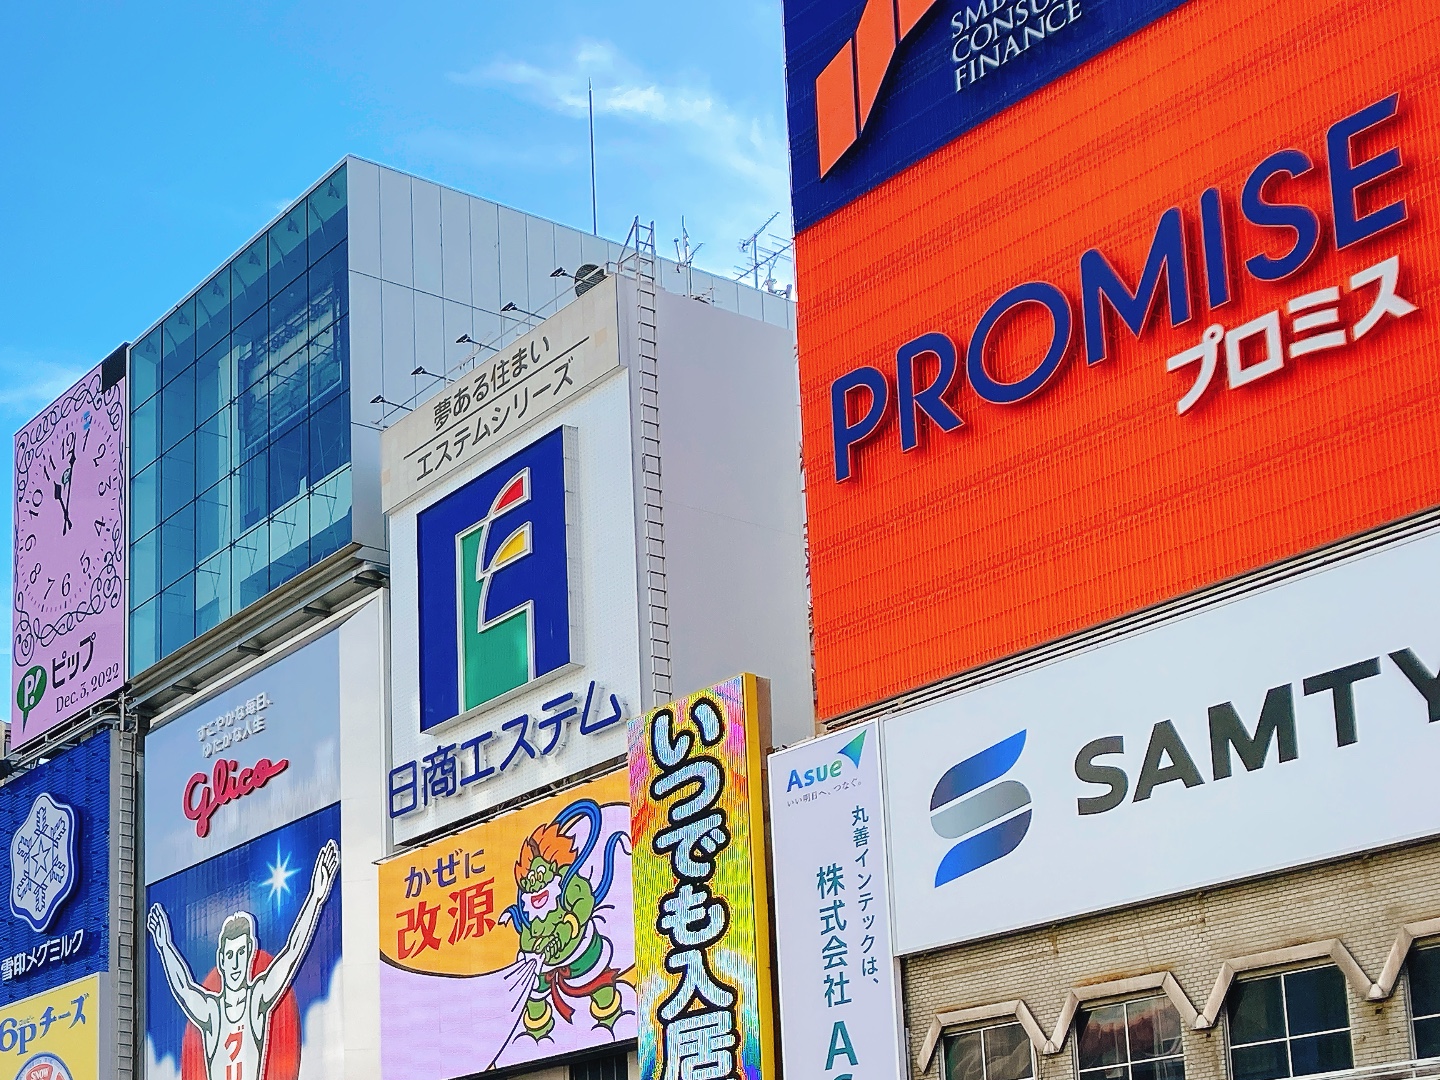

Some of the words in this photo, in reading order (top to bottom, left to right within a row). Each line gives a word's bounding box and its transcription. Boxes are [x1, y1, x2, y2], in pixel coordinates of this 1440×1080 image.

[952, 0, 1062, 62] CONSU
[954, 0, 1083, 93] FINANCE
[831, 91, 1409, 481] PROMISE
[1166, 255, 1419, 416] プロミス
[416, 358, 577, 481] エステムシリーズ
[433, 336, 550, 430] 夢ある住まい
[52, 631, 96, 689] ピップ
[91, 663, 119, 692] 2022
[196, 691, 273, 741] すこやかな毎日、
[202, 716, 266, 758] ゆたかな人生
[388, 680, 623, 819] 日商エステム
[1074, 647, 1440, 815] SAMTY
[182, 758, 290, 838] Glico
[786, 759, 843, 793] Asue
[404, 848, 485, 899] かぜに
[851, 805, 880, 985] 丸善インテックは、
[0, 929, 85, 982] 雪印メグミルク
[396, 877, 496, 961] 改源
[816, 862, 853, 1008] 株式会社
